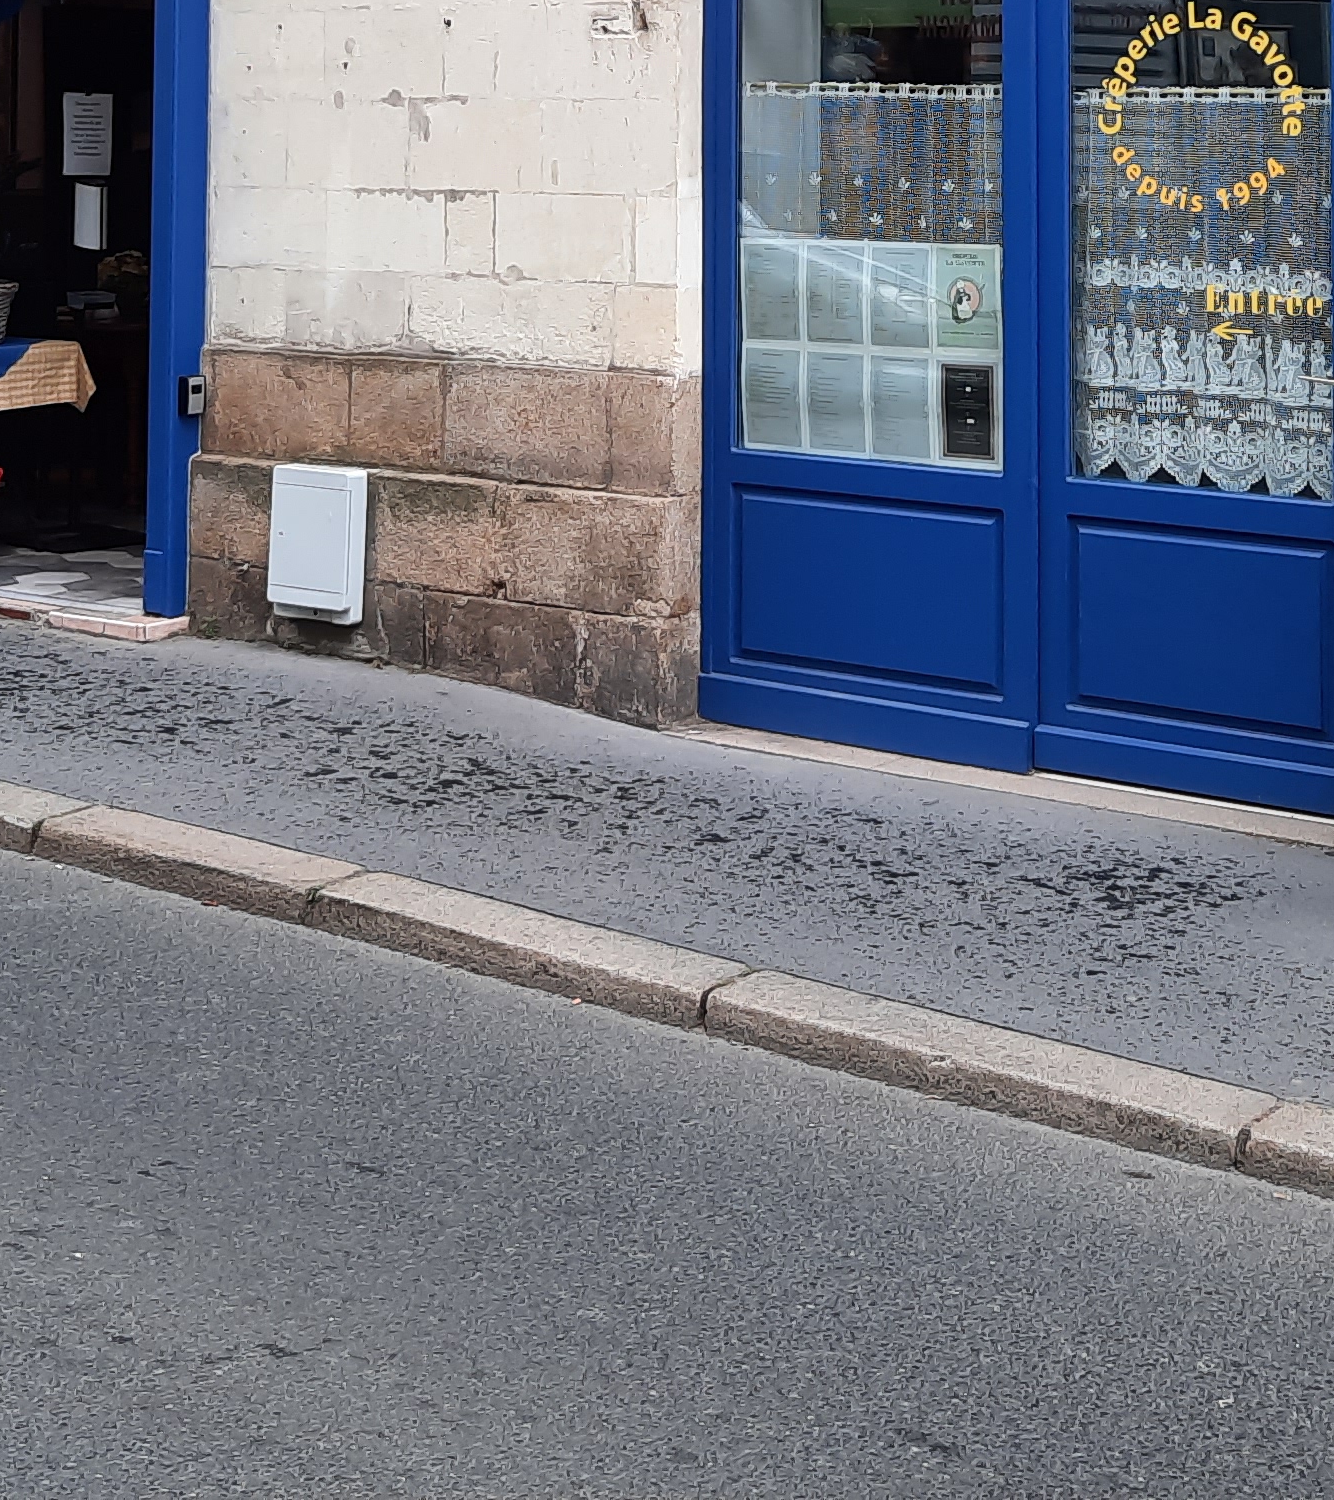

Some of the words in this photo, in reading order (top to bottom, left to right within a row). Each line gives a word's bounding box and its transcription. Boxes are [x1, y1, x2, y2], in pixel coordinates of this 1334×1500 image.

[1098, 10, 1181, 135] Crêperie
[1187, 1, 1222, 31] La
[1231, 11, 1303, 137] Gavotte
[1112, 145, 1203, 213] depuis
[1216, 156, 1286, 211] 1994
[1206, 284, 1324, 317] Entrée
